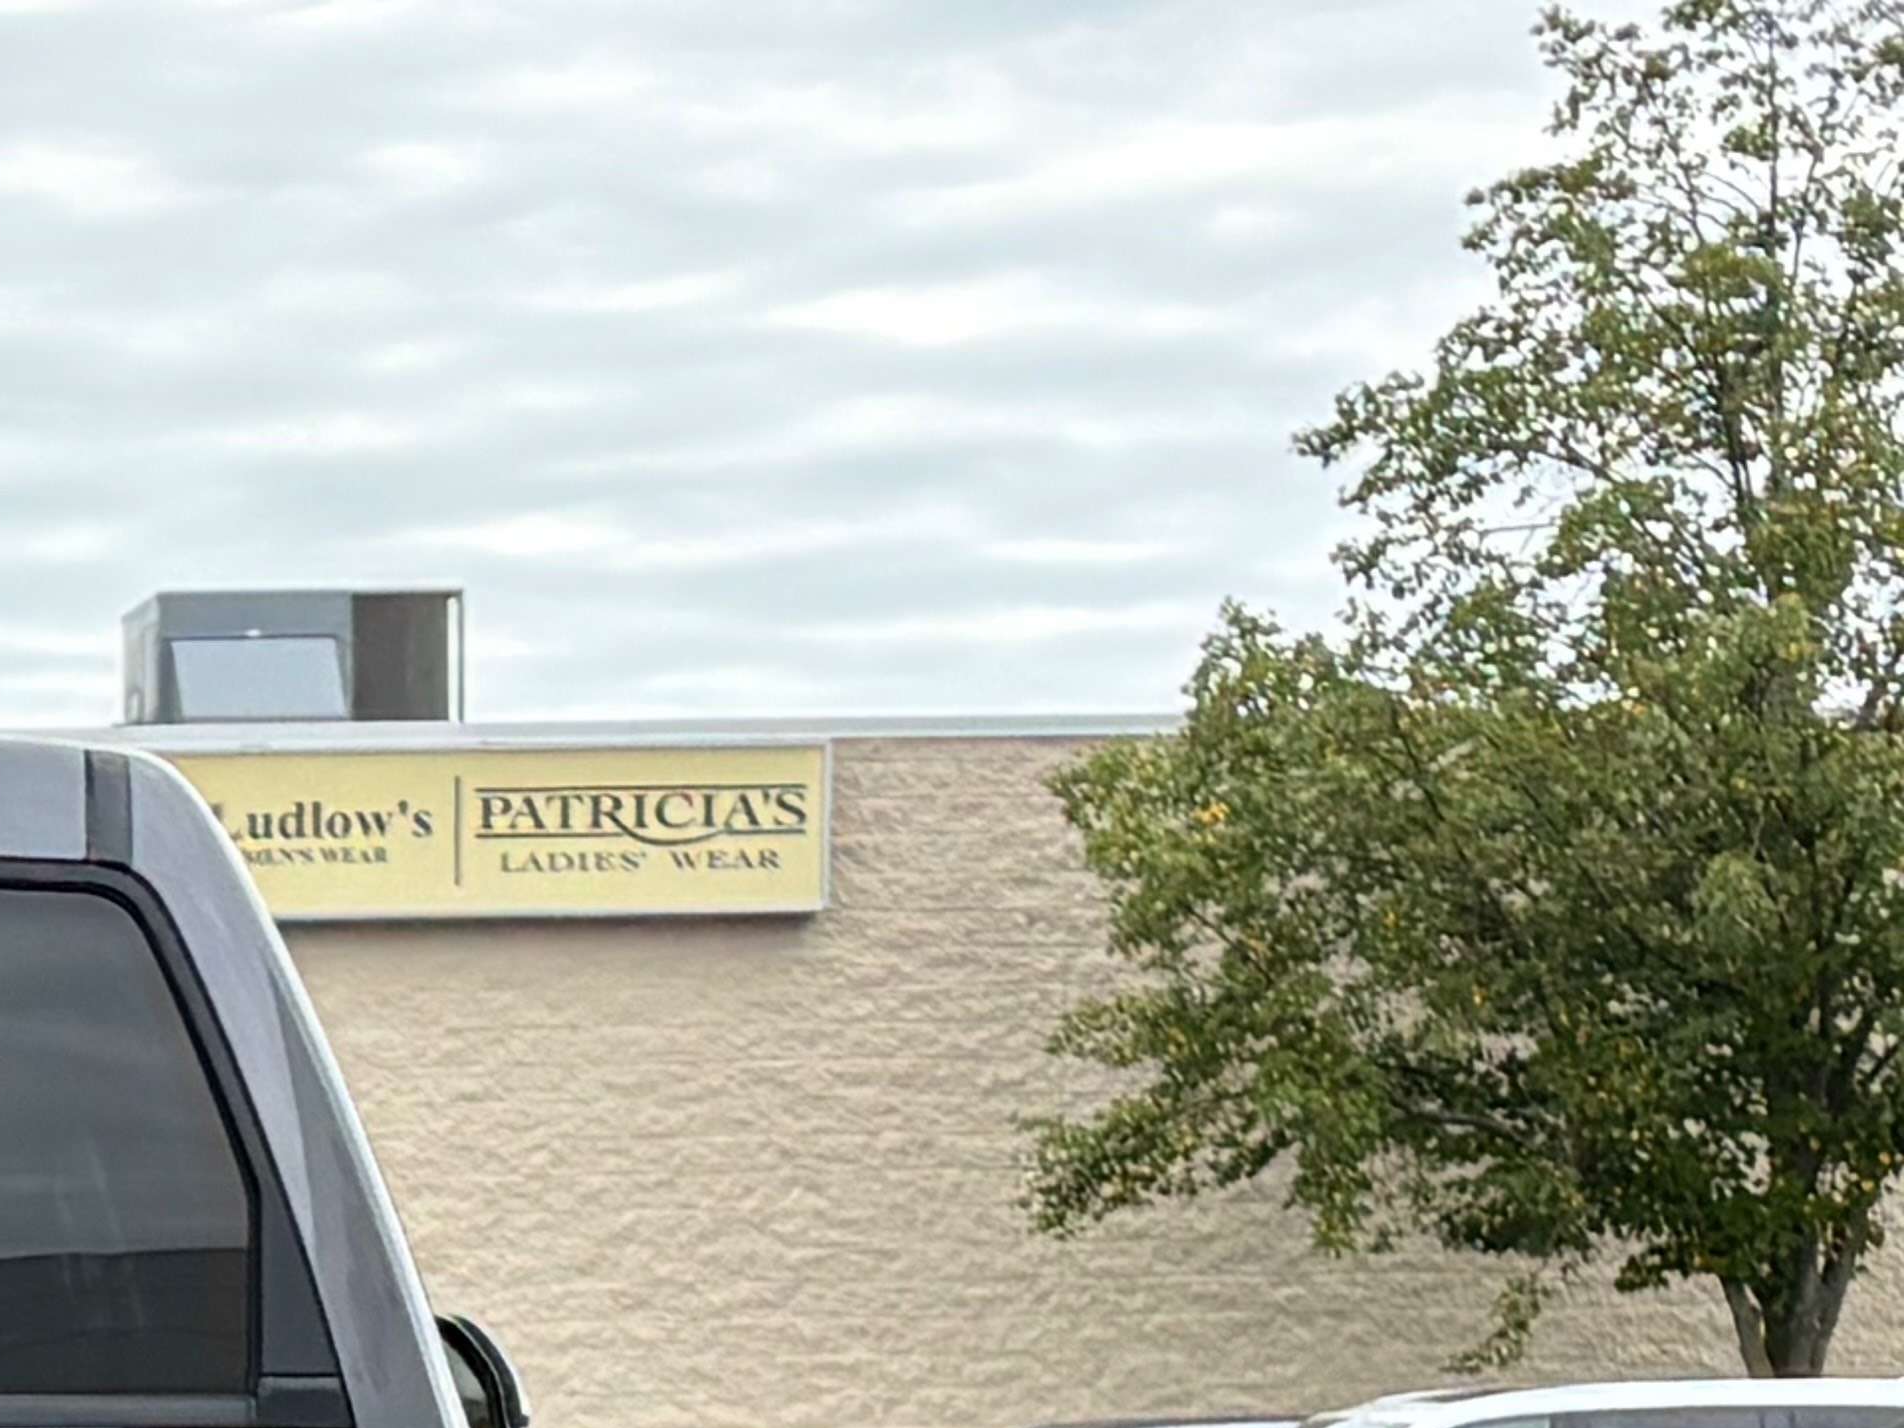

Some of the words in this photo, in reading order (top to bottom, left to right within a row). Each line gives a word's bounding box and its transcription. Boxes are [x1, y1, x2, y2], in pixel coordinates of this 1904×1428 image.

[480, 791, 807, 845] PATRICIA'S
[319, 846, 388, 863] WEAR
[669, 849, 781, 870] WEAR
